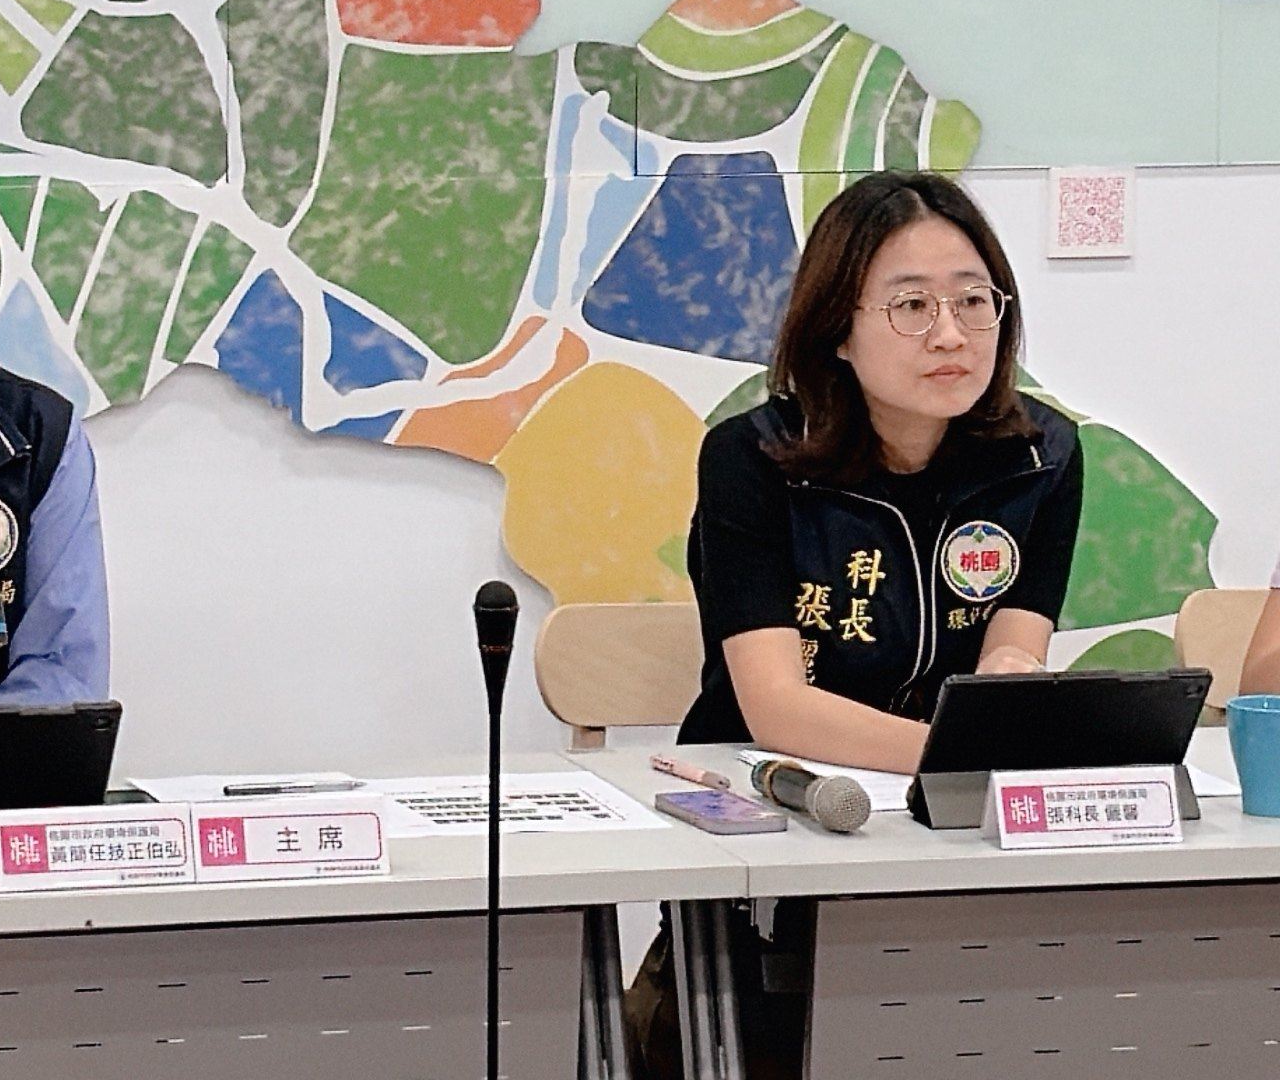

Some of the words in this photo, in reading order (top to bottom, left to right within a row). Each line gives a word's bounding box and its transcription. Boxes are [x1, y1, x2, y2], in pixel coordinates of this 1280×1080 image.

[960, 550, 1000, 572] 桃園
[838, 548, 886, 643] 科長
[1047, 805, 1101, 825] 張科長
[276, 824, 344, 853] 主席
